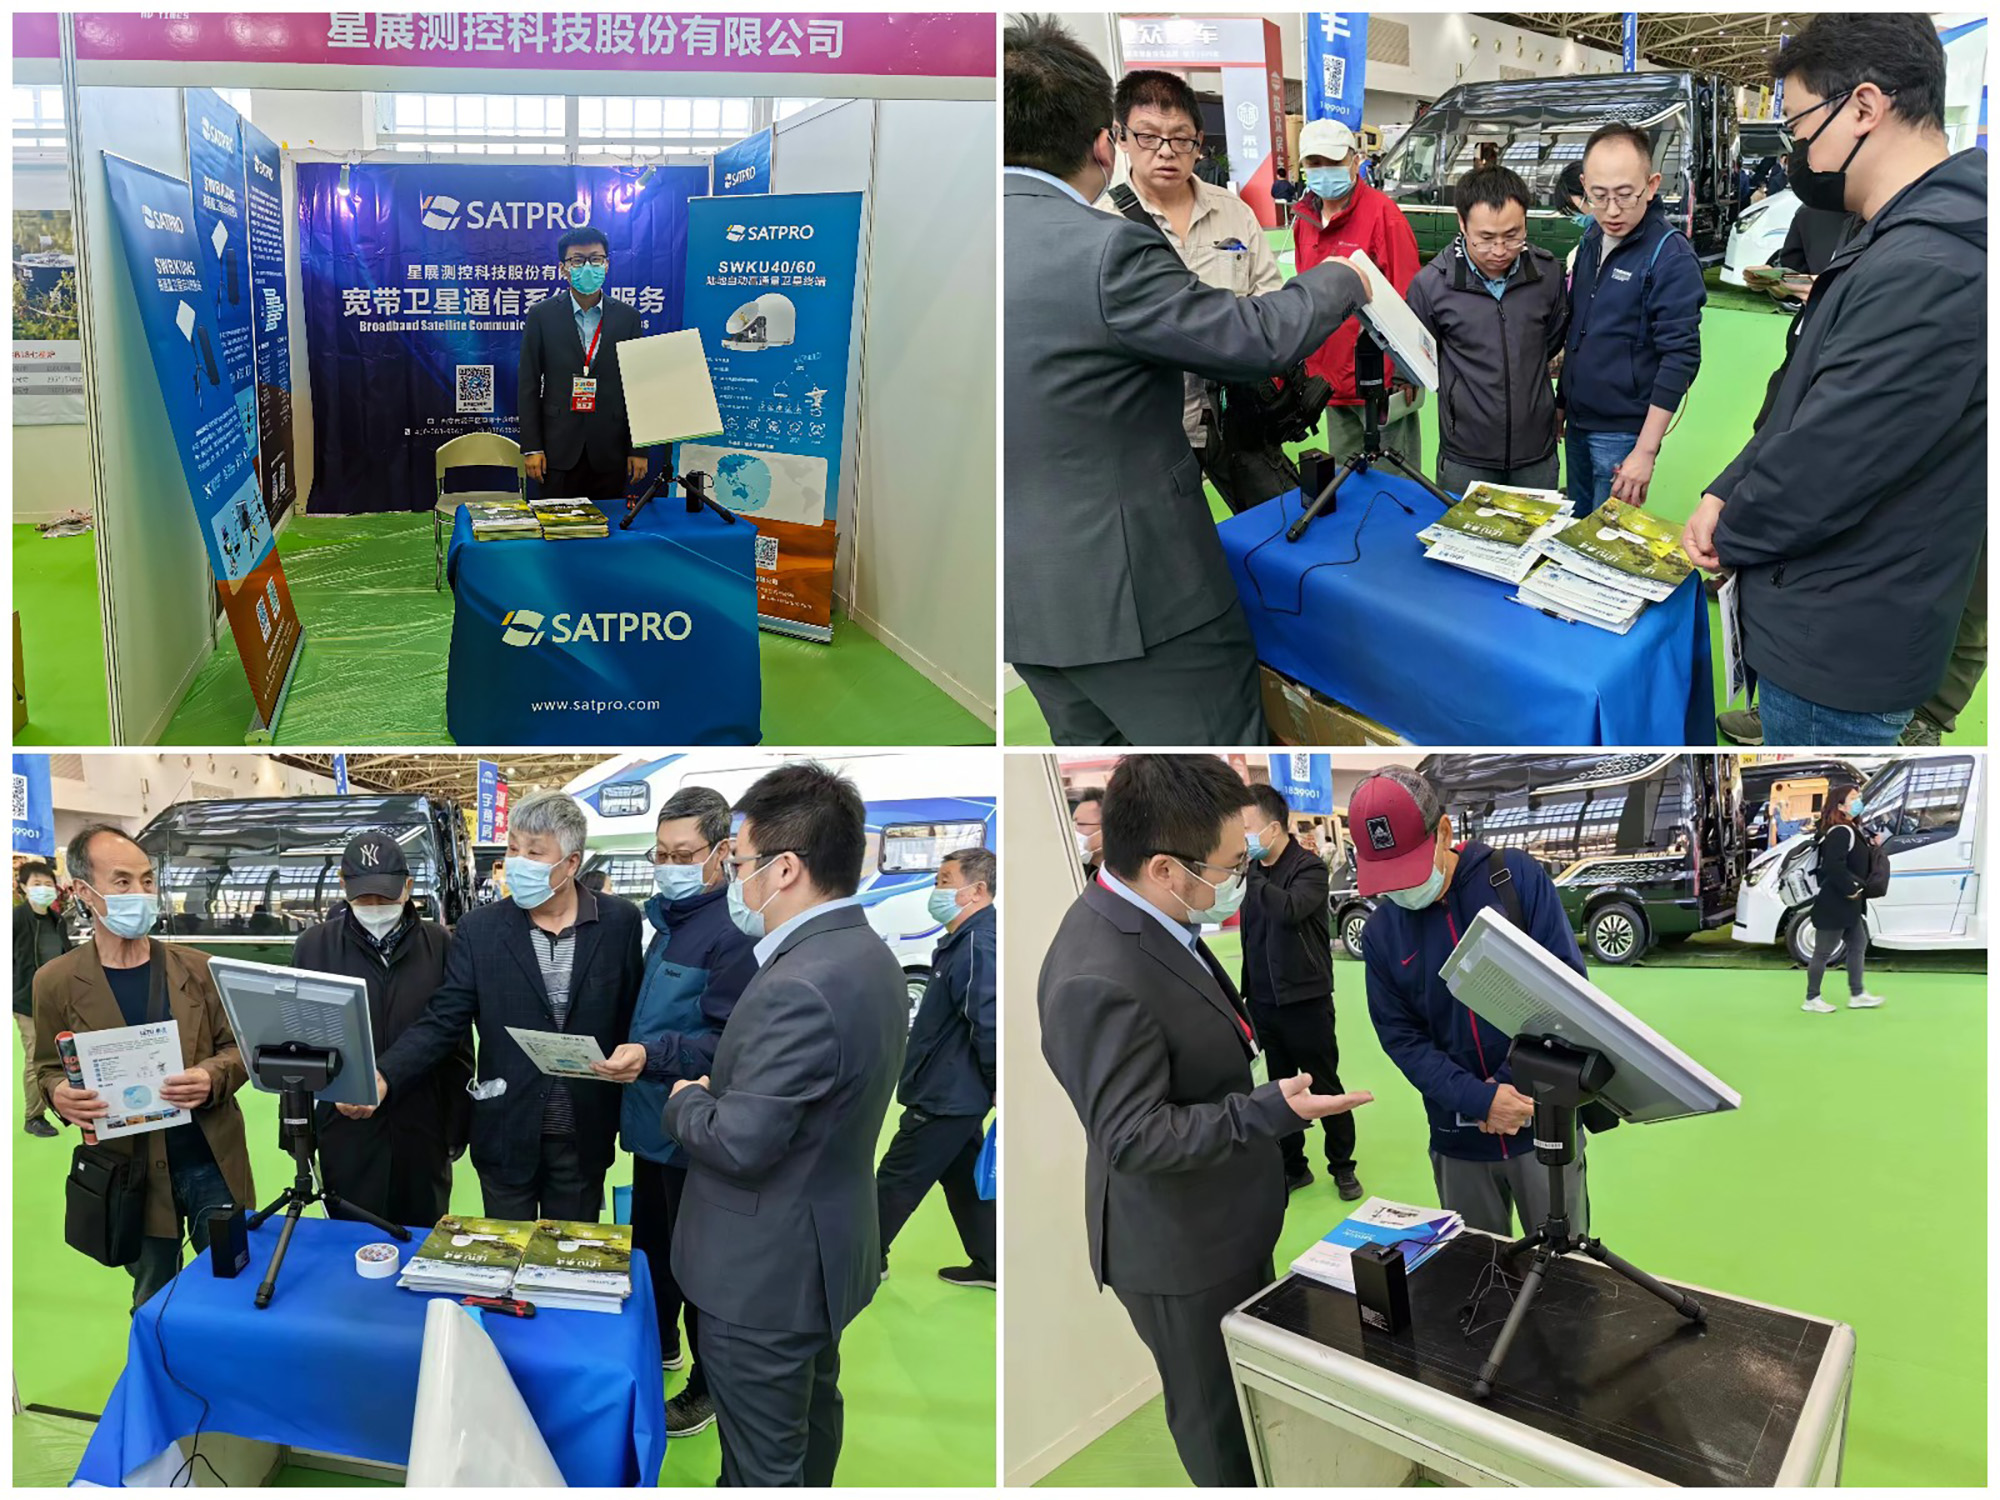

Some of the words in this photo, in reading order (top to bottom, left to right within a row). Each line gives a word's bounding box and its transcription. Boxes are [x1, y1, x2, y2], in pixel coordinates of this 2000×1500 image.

[327, 12, 844, 59] 星展测控科技股份有限公司
[466, 199, 591, 230] SATPRO
[748, 224, 814, 241] SATPRO
[718, 260, 816, 274] SWKU40/60
[359, 319, 420, 333] Broadband
[420, 319, 468, 332] Satellite
[551, 610, 693, 644] SATPRO
[531, 699, 661, 715] www.satpro.com
